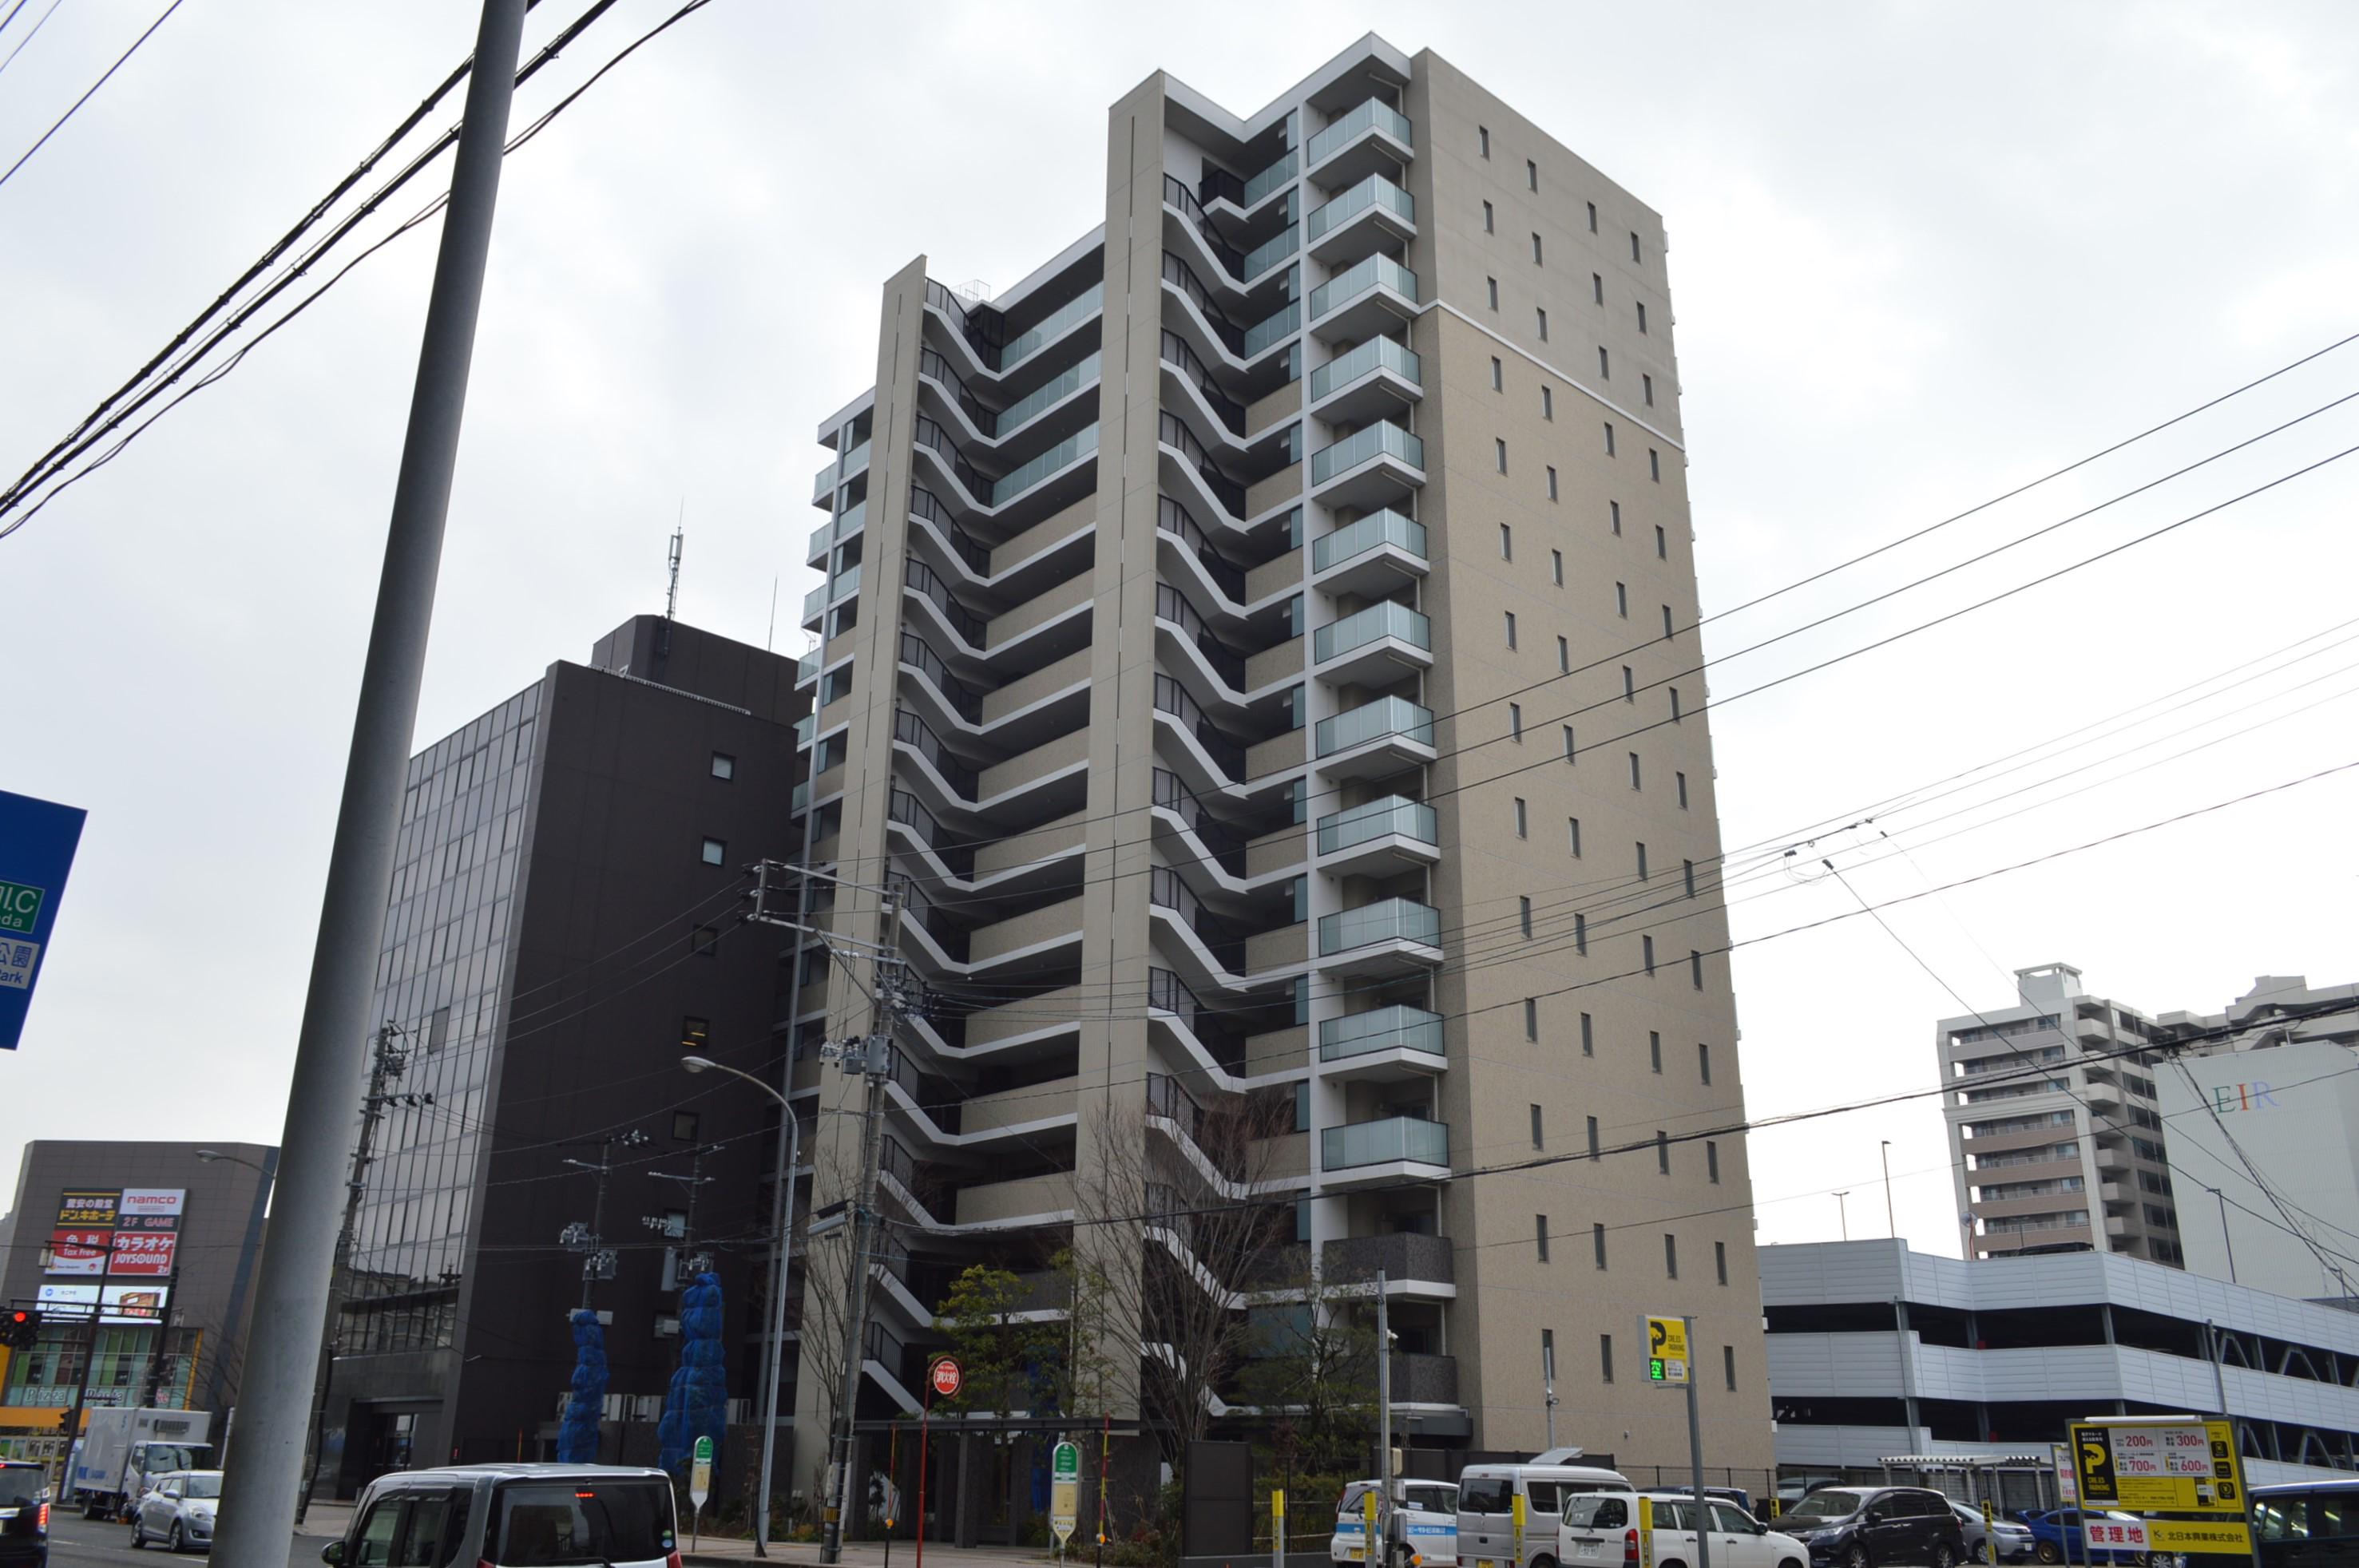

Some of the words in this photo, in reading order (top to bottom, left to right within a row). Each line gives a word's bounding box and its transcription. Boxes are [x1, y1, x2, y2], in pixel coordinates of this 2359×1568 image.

[0, 969, 22, 984] ark
[2211, 1082, 2281, 1113] EIR
[127, 1195, 177, 1205] namco
[122, 1218, 138, 1227] 2F
[144, 1218, 174, 1228] GAME
[117, 1237, 173, 1251] カラオケ
[115, 1253, 167, 1265] JOYSOUND
[1650, 1360, 1663, 1380] 空
[936, 1371, 957, 1384] 消火栓
[25, 1386, 66, 1403] Pizza
[2125, 1435, 2153, 1447] 200円
[2176, 1435, 2204, 1447] 300円
[2128, 1460, 2157, 1472] 700円
[2180, 1460, 2209, 1472] 600円
[2089, 1526, 2144, 1544] 管理地
